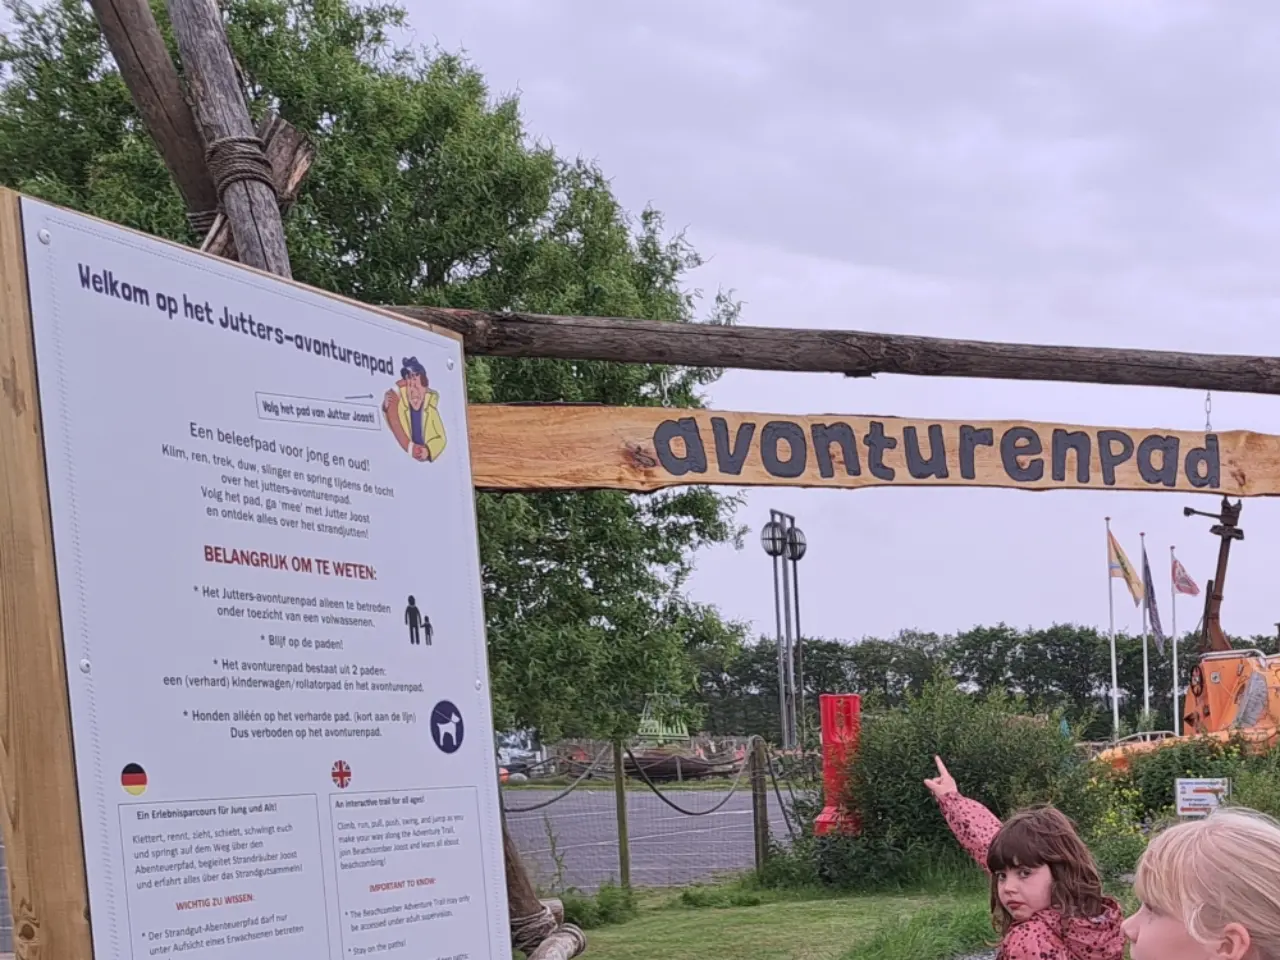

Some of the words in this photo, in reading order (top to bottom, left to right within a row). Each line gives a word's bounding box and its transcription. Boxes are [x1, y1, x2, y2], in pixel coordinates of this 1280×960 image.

[77, 263, 150, 306] Welkom
[155, 292, 178, 320] op
[182, 293, 214, 325] het
[218, 306, 394, 376] Jutters-avonturenpad
[262, 400, 279, 416] Volg
[279, 402, 294, 415] het
[295, 405, 310, 418] pad
[311, 409, 325, 418] van
[326, 407, 351, 420] Jutter
[189, 421, 213, 440] Een
[216, 427, 276, 453] beleefpad
[279, 443, 303, 458] voor
[306, 446, 330, 466] jong
[332, 455, 345, 466] en
[652, 415, 1221, 489] avonturenpad
[220, 474, 241, 486] over
[243, 476, 259, 489] het
[261, 464, 291, 479] slinger
[293, 471, 304, 480] en
[306, 473, 333, 488] spring
[333, 477, 361, 491] tijdens
[362, 483, 373, 493] de
[374, 484, 394, 497] tocht
[200, 485, 223, 503] Volg
[224, 490, 240, 503] het
[265, 498, 277, 510] ga
[305, 505, 322, 516] met
[324, 506, 347, 519] Jutter
[349, 511, 370, 523] Joost
[206, 506, 219, 516] en
[220, 509, 254, 521] ontdek
[256, 513, 278, 525] alles
[279, 518, 298, 528] over
[300, 519, 315, 531] het
[204, 544, 288, 570] BELANGRIJK
[291, 556, 312, 573] OM
[314, 558, 330, 575] TE
[202, 585, 220, 598] Het
[222, 587, 317, 607] Jutters-avonturenpad
[319, 598, 344, 608] alleen
[346, 600, 354, 610] te
[356, 601, 391, 613] betreden
[216, 605, 244, 617] onder
[246, 608, 283, 620] toezicht
[285, 612, 301, 621] van
[303, 614, 319, 623] een
[268, 634, 286, 648] Blijf
[288, 638, 300, 649] op
[301, 637, 312, 648] de
[221, 658, 239, 670] Het
[241, 661, 303, 674] avonturenpad
[305, 662, 337, 674] bestaat
[339, 665, 350, 674] uit
[351, 664, 358, 675] 2
[163, 676, 182, 686] een
[185, 675, 230, 688] (verhard)
[231, 676, 342, 691] kinderwagen/rollatorpad
[355, 680, 369, 690] het
[191, 709, 230, 721] Honden
[263, 712, 276, 723] op
[277, 710, 292, 721] het
[294, 711, 332, 721] verharde
[374, 713, 389, 721] aan
[390, 712, 400, 721] de
[230, 726, 249, 738] Dus
[250, 727, 293, 738] verboden
[295, 729, 306, 740] op
[307, 727, 323, 737] het
